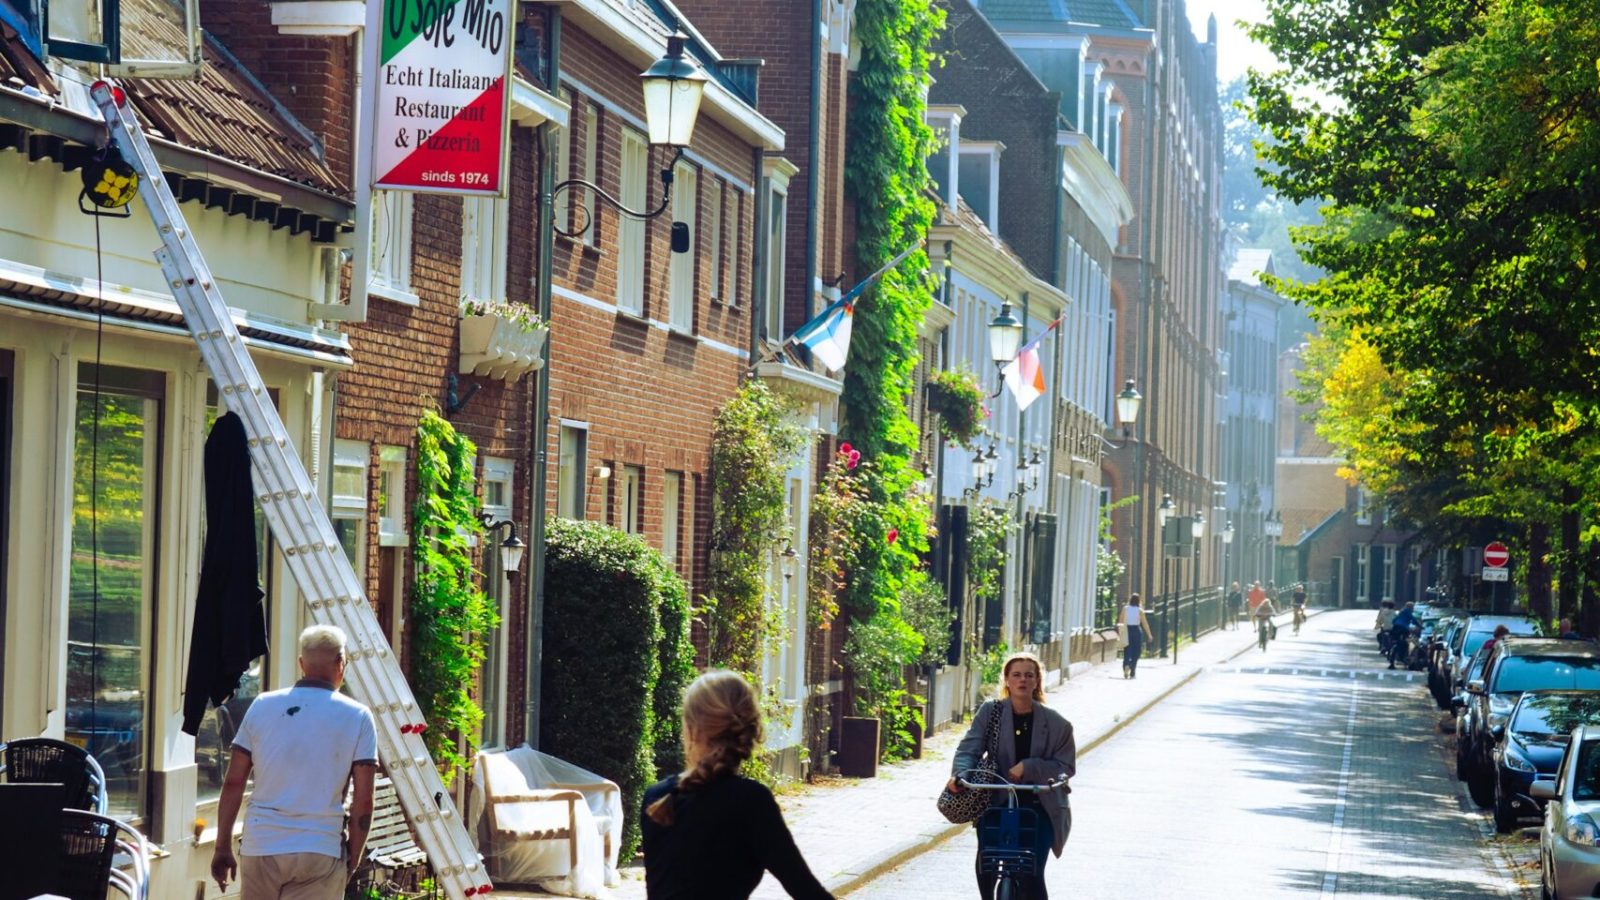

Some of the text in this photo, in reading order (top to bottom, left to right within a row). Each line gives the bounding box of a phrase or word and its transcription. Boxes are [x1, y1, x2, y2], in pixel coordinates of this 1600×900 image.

[462, 0, 503, 55] Mio
[386, 64, 499, 90] Echt Italiaans
[395, 96, 486, 122] Restaurant
[395, 127, 480, 152] & Pizzeria
[421, 170, 489, 185] sinds 1974
